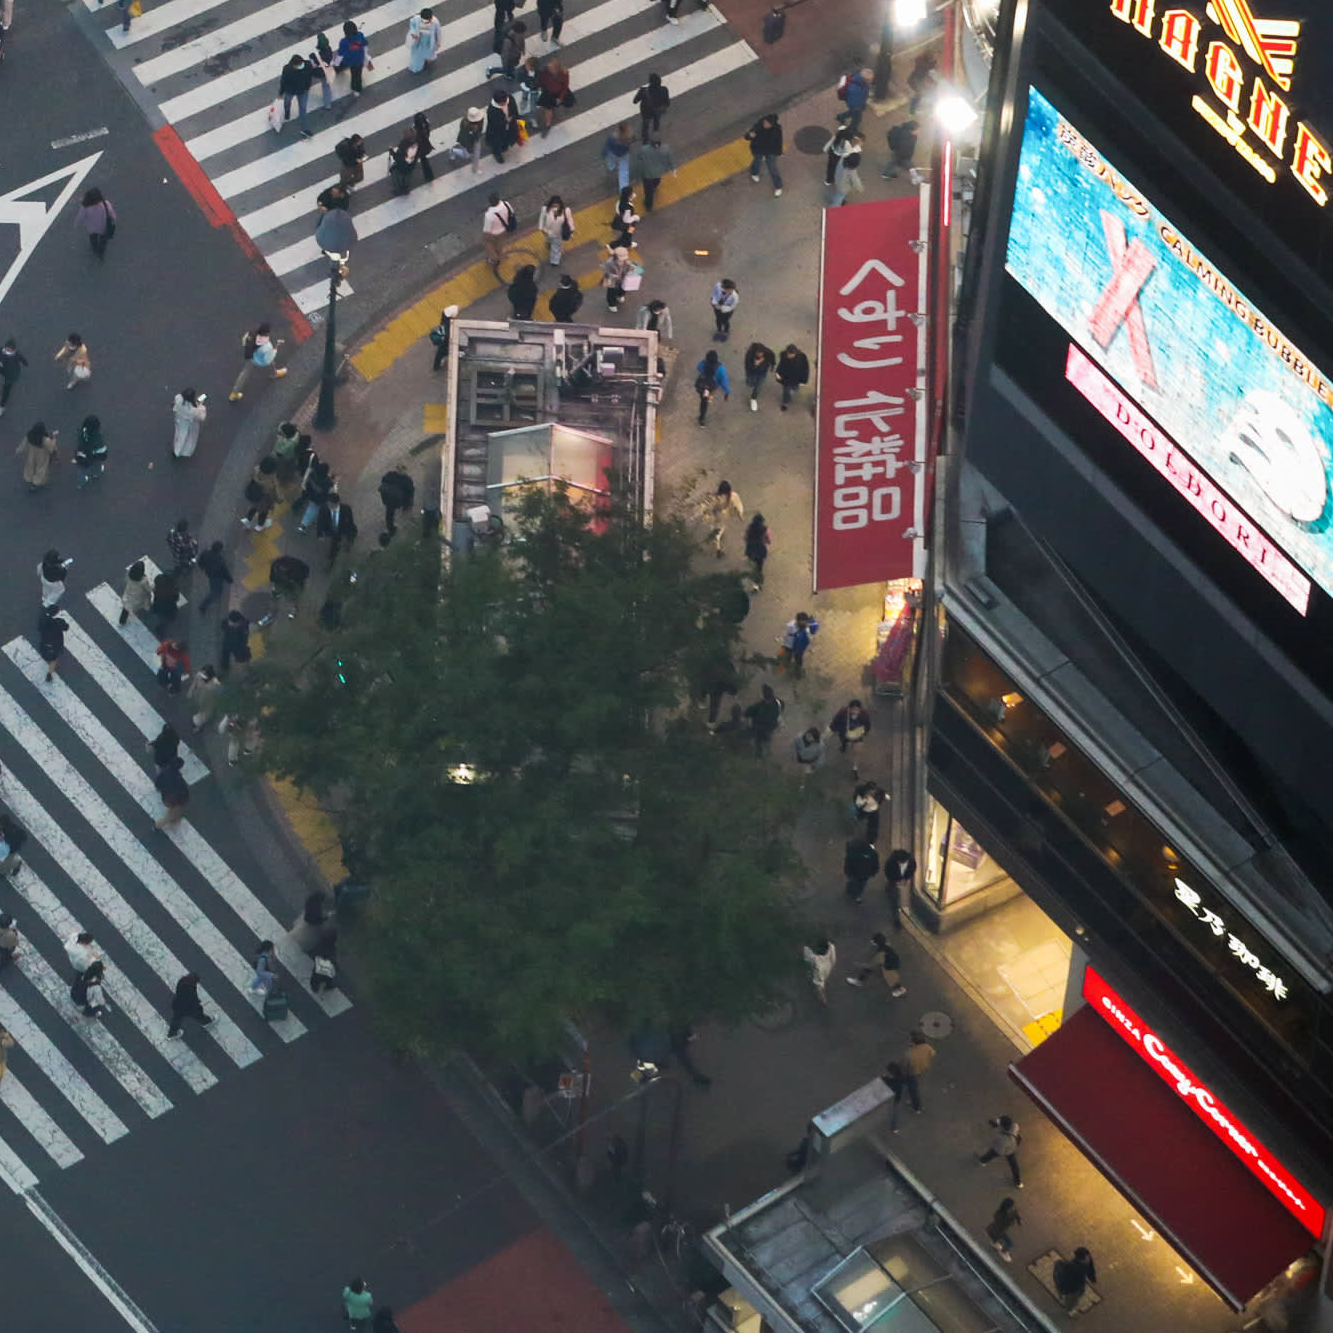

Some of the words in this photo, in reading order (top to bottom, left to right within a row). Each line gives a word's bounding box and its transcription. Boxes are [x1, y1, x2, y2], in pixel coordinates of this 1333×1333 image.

[837, 258, 906, 369] くすり
[1160, 226, 1247, 319] CALMING
[1252, 318, 1329, 397] BUBBLE
[833, 390, 908, 531] 化粧品
[1102, 996, 1141, 1041] GINZA
